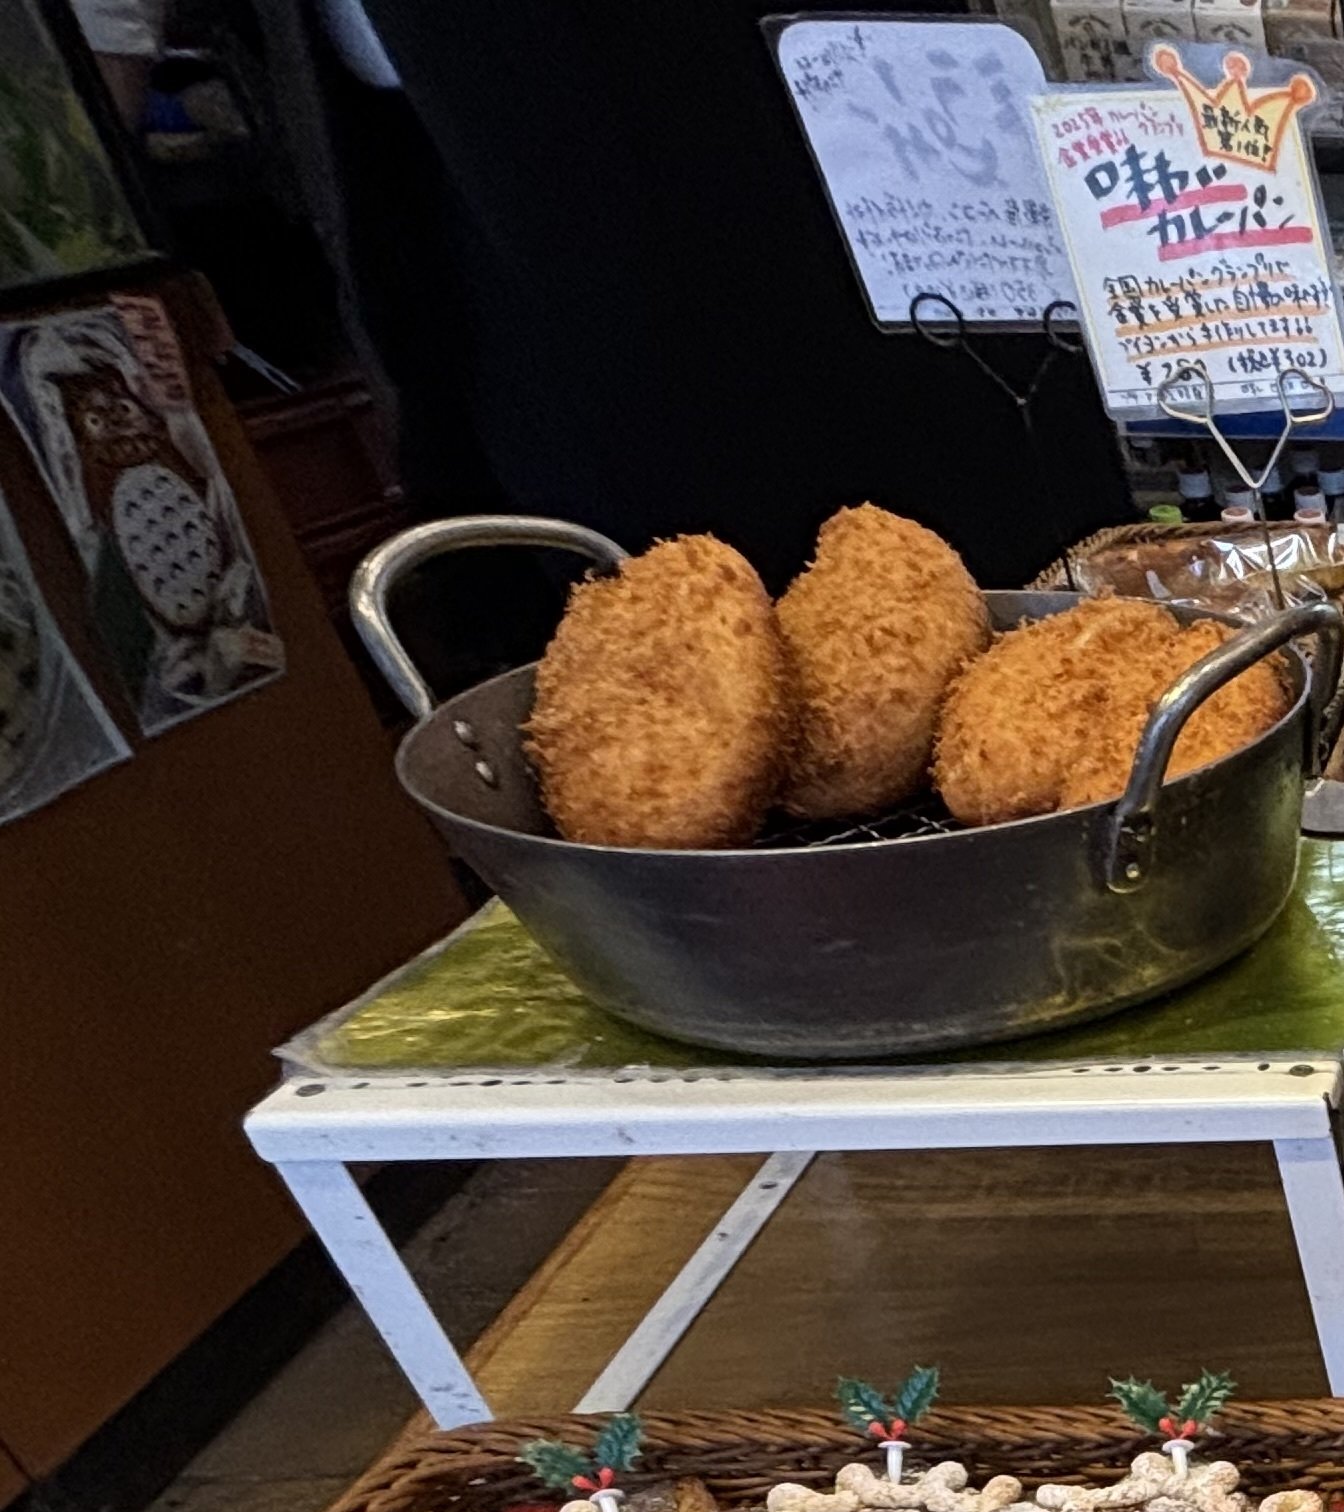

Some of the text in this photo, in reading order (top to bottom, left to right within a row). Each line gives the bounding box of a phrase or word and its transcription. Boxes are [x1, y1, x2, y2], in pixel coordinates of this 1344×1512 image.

[1147, 184, 1296, 246] カレーパン
